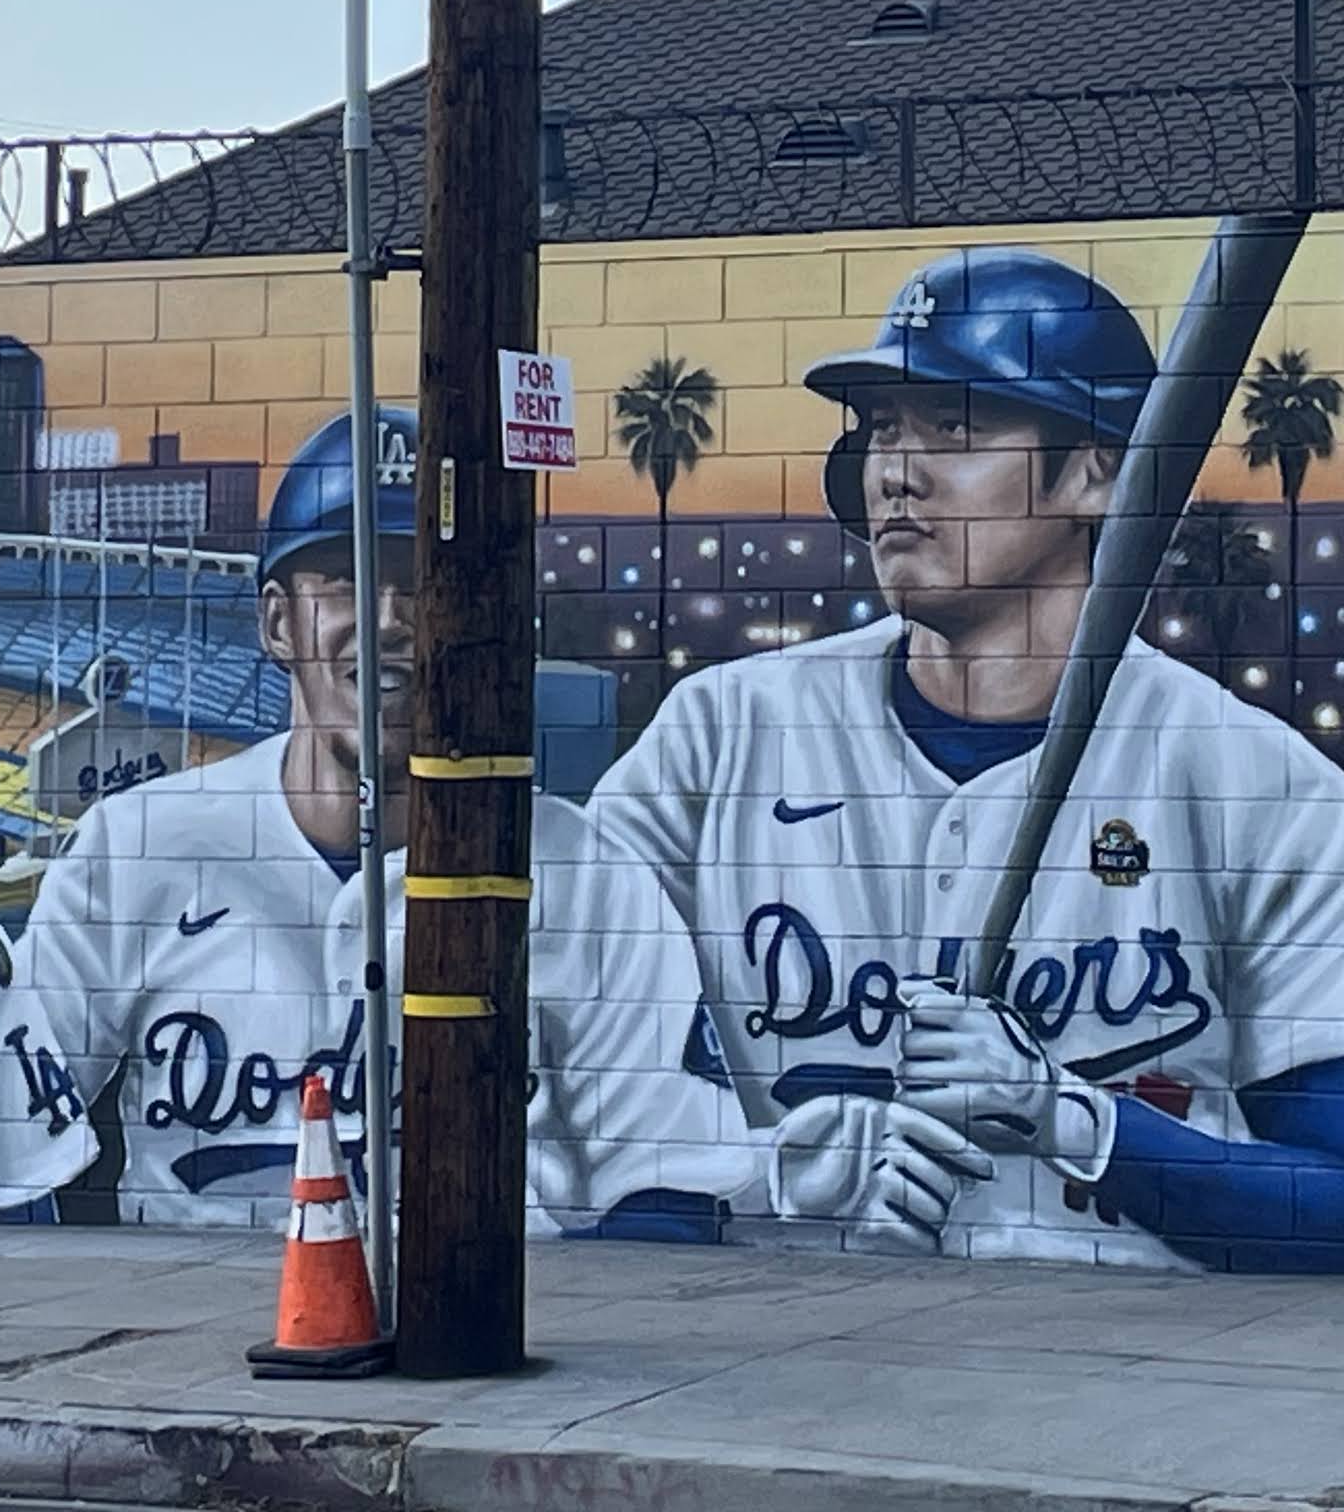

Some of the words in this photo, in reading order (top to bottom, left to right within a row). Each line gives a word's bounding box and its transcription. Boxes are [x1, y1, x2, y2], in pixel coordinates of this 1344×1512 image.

[518, 359, 555, 391] FOR
[514, 392, 562, 423] RENT
[375, 421, 417, 485] LA
[4, 1024, 84, 1137] LA
